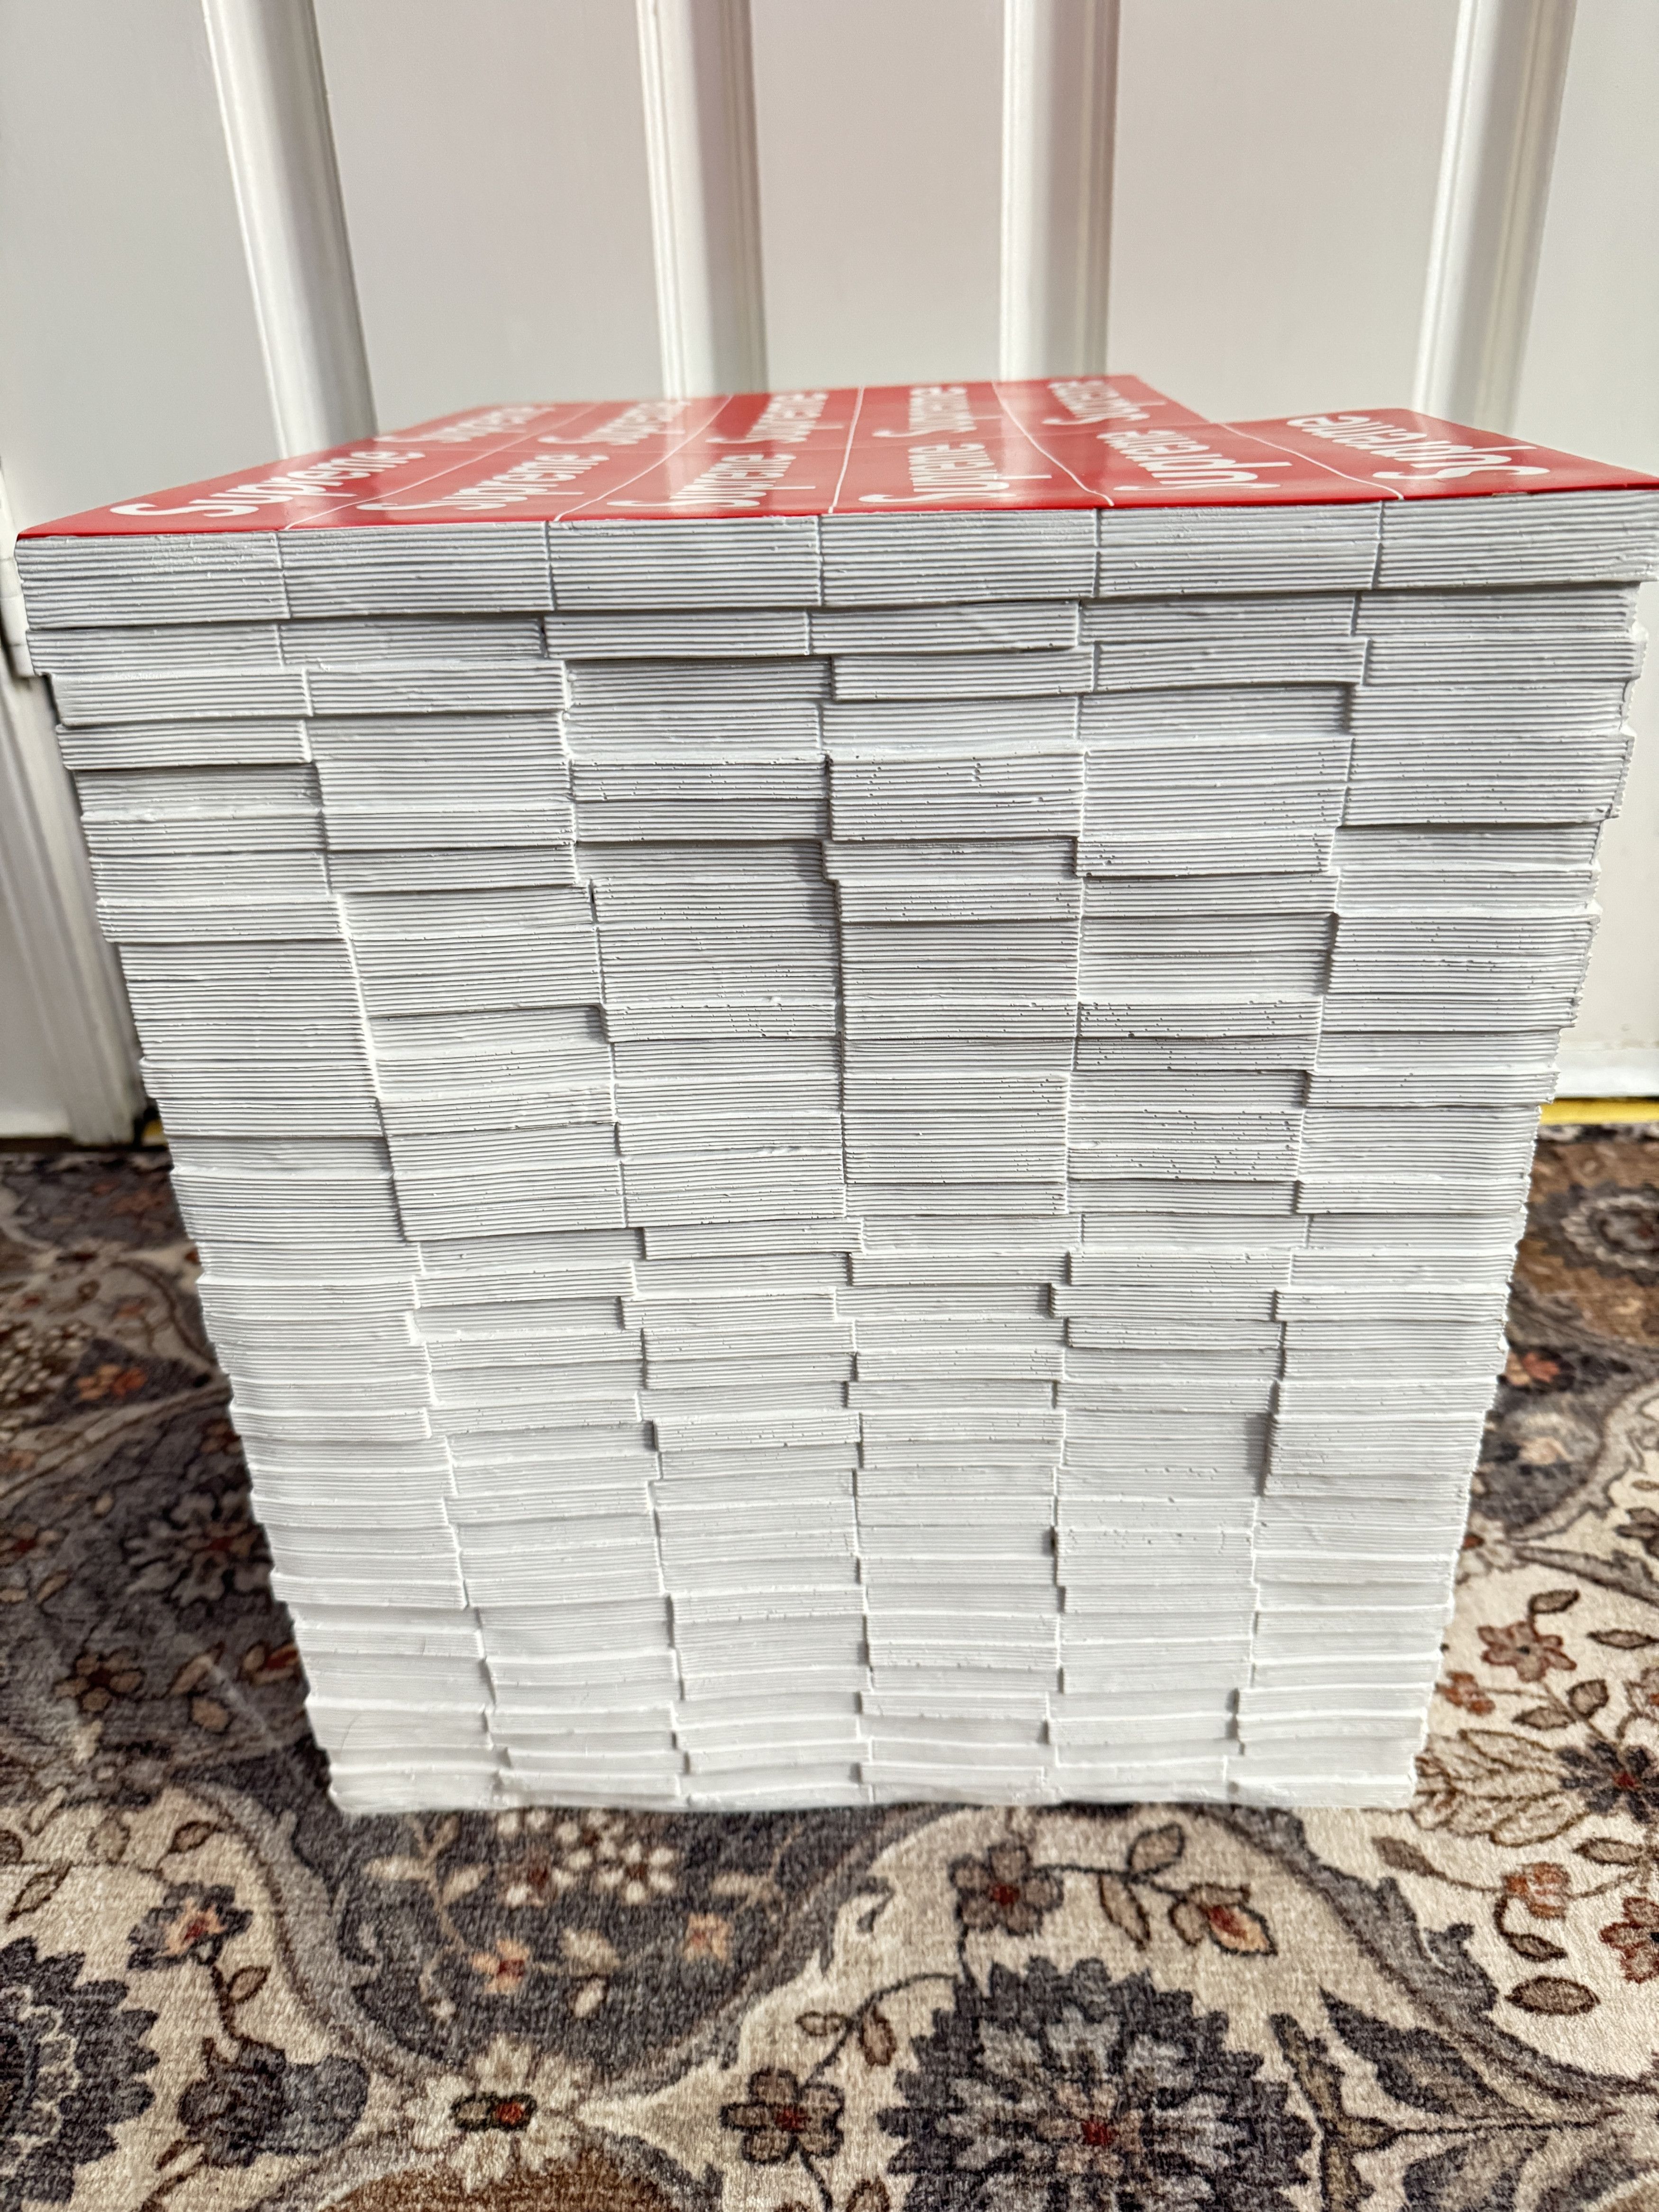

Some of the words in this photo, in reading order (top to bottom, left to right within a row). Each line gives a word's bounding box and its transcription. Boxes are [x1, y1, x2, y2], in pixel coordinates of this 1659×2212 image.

[858, 443, 1052, 502] Supreme
[1096, 430, 1293, 491] Supreme
[1286, 415, 1550, 479] Supreme
[109, 451, 426, 518] Supreme
[356, 454, 610, 510] Supreme
[607, 453, 816, 508] Supreme
